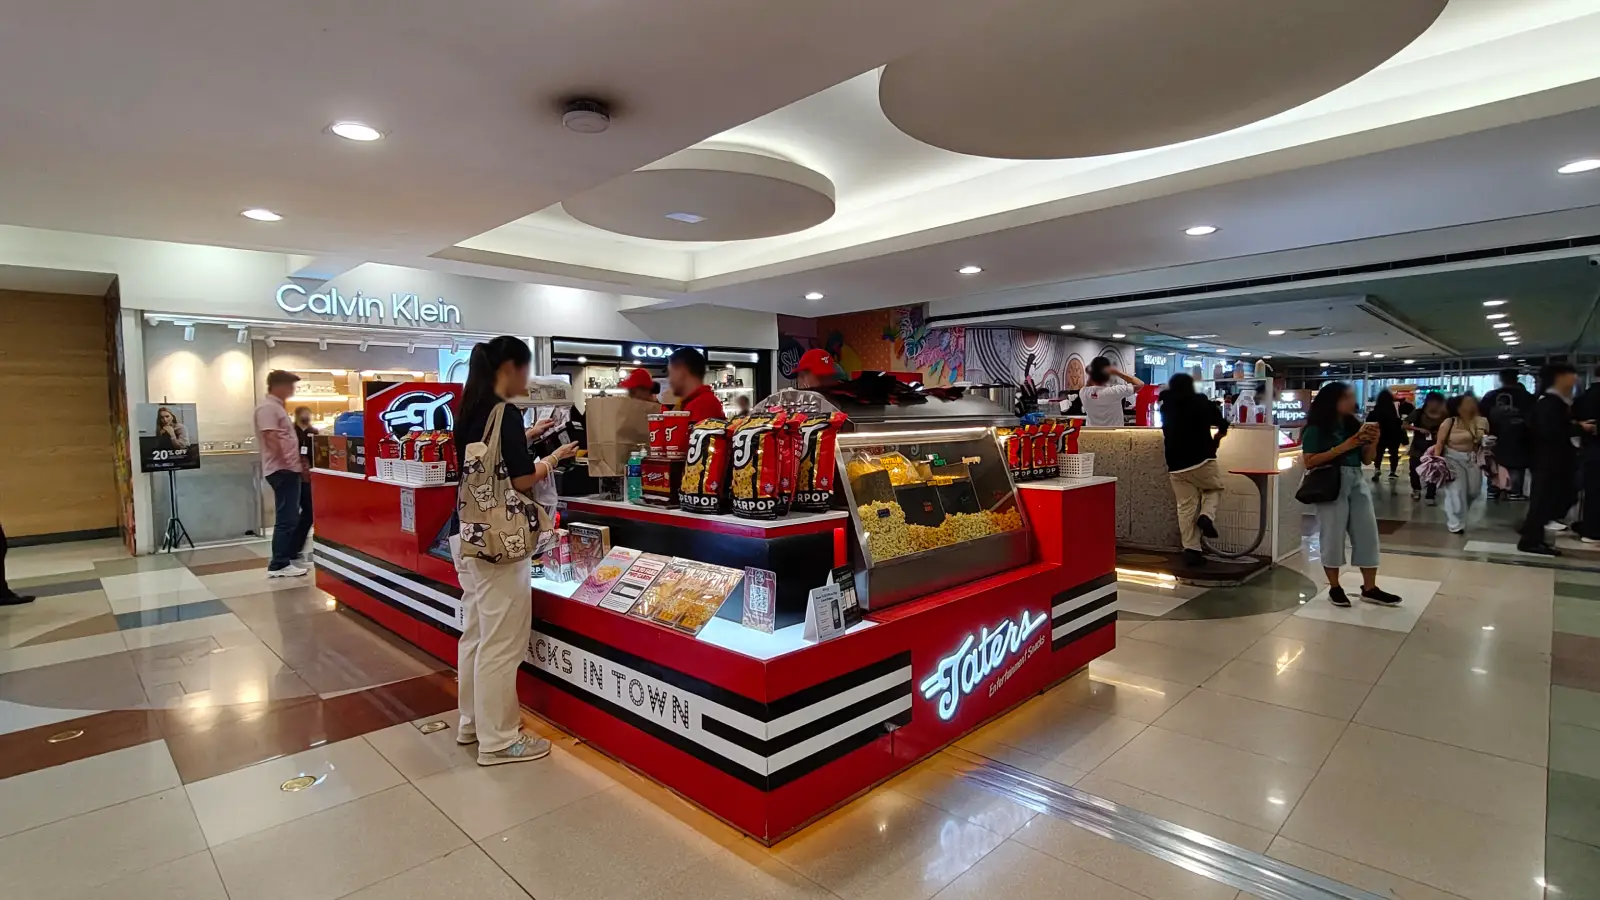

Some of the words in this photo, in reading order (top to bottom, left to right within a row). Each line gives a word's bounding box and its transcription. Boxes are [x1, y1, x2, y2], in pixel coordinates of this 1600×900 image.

[275, 284, 384, 319] Calvin
[391, 292, 461, 325] Klein
[1272, 400, 1302, 409] Marcel
[583, 658, 603, 690] IN
[611, 669, 690, 729] TOWN
[920, 610, 1048, 720] Taters
[988, 653, 1027, 697] Entertainment
[1027, 635, 1046, 659] Snacks
